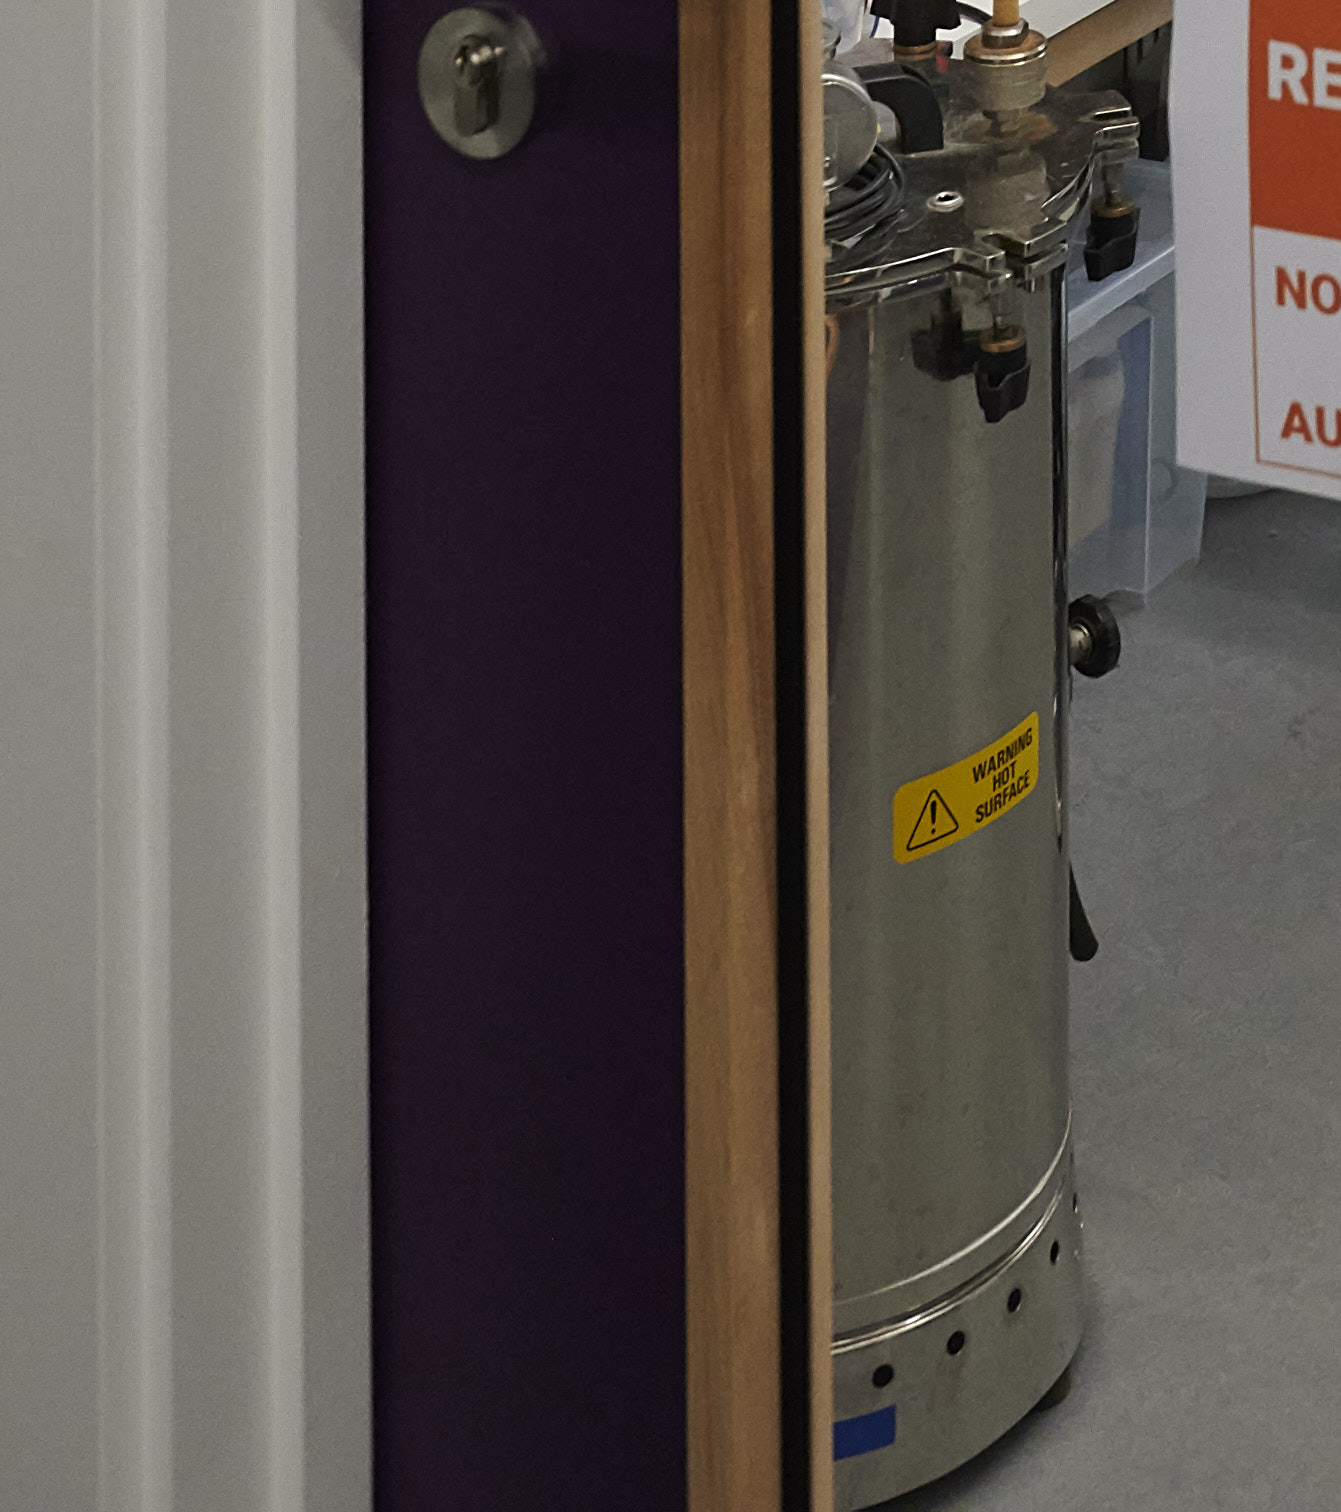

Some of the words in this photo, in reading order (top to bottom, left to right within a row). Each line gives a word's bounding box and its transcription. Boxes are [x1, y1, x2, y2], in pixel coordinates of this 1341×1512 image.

[972, 727, 1033, 784] WARNING
[992, 760, 1017, 793] HOT
[975, 770, 1031, 824] SURFACE
